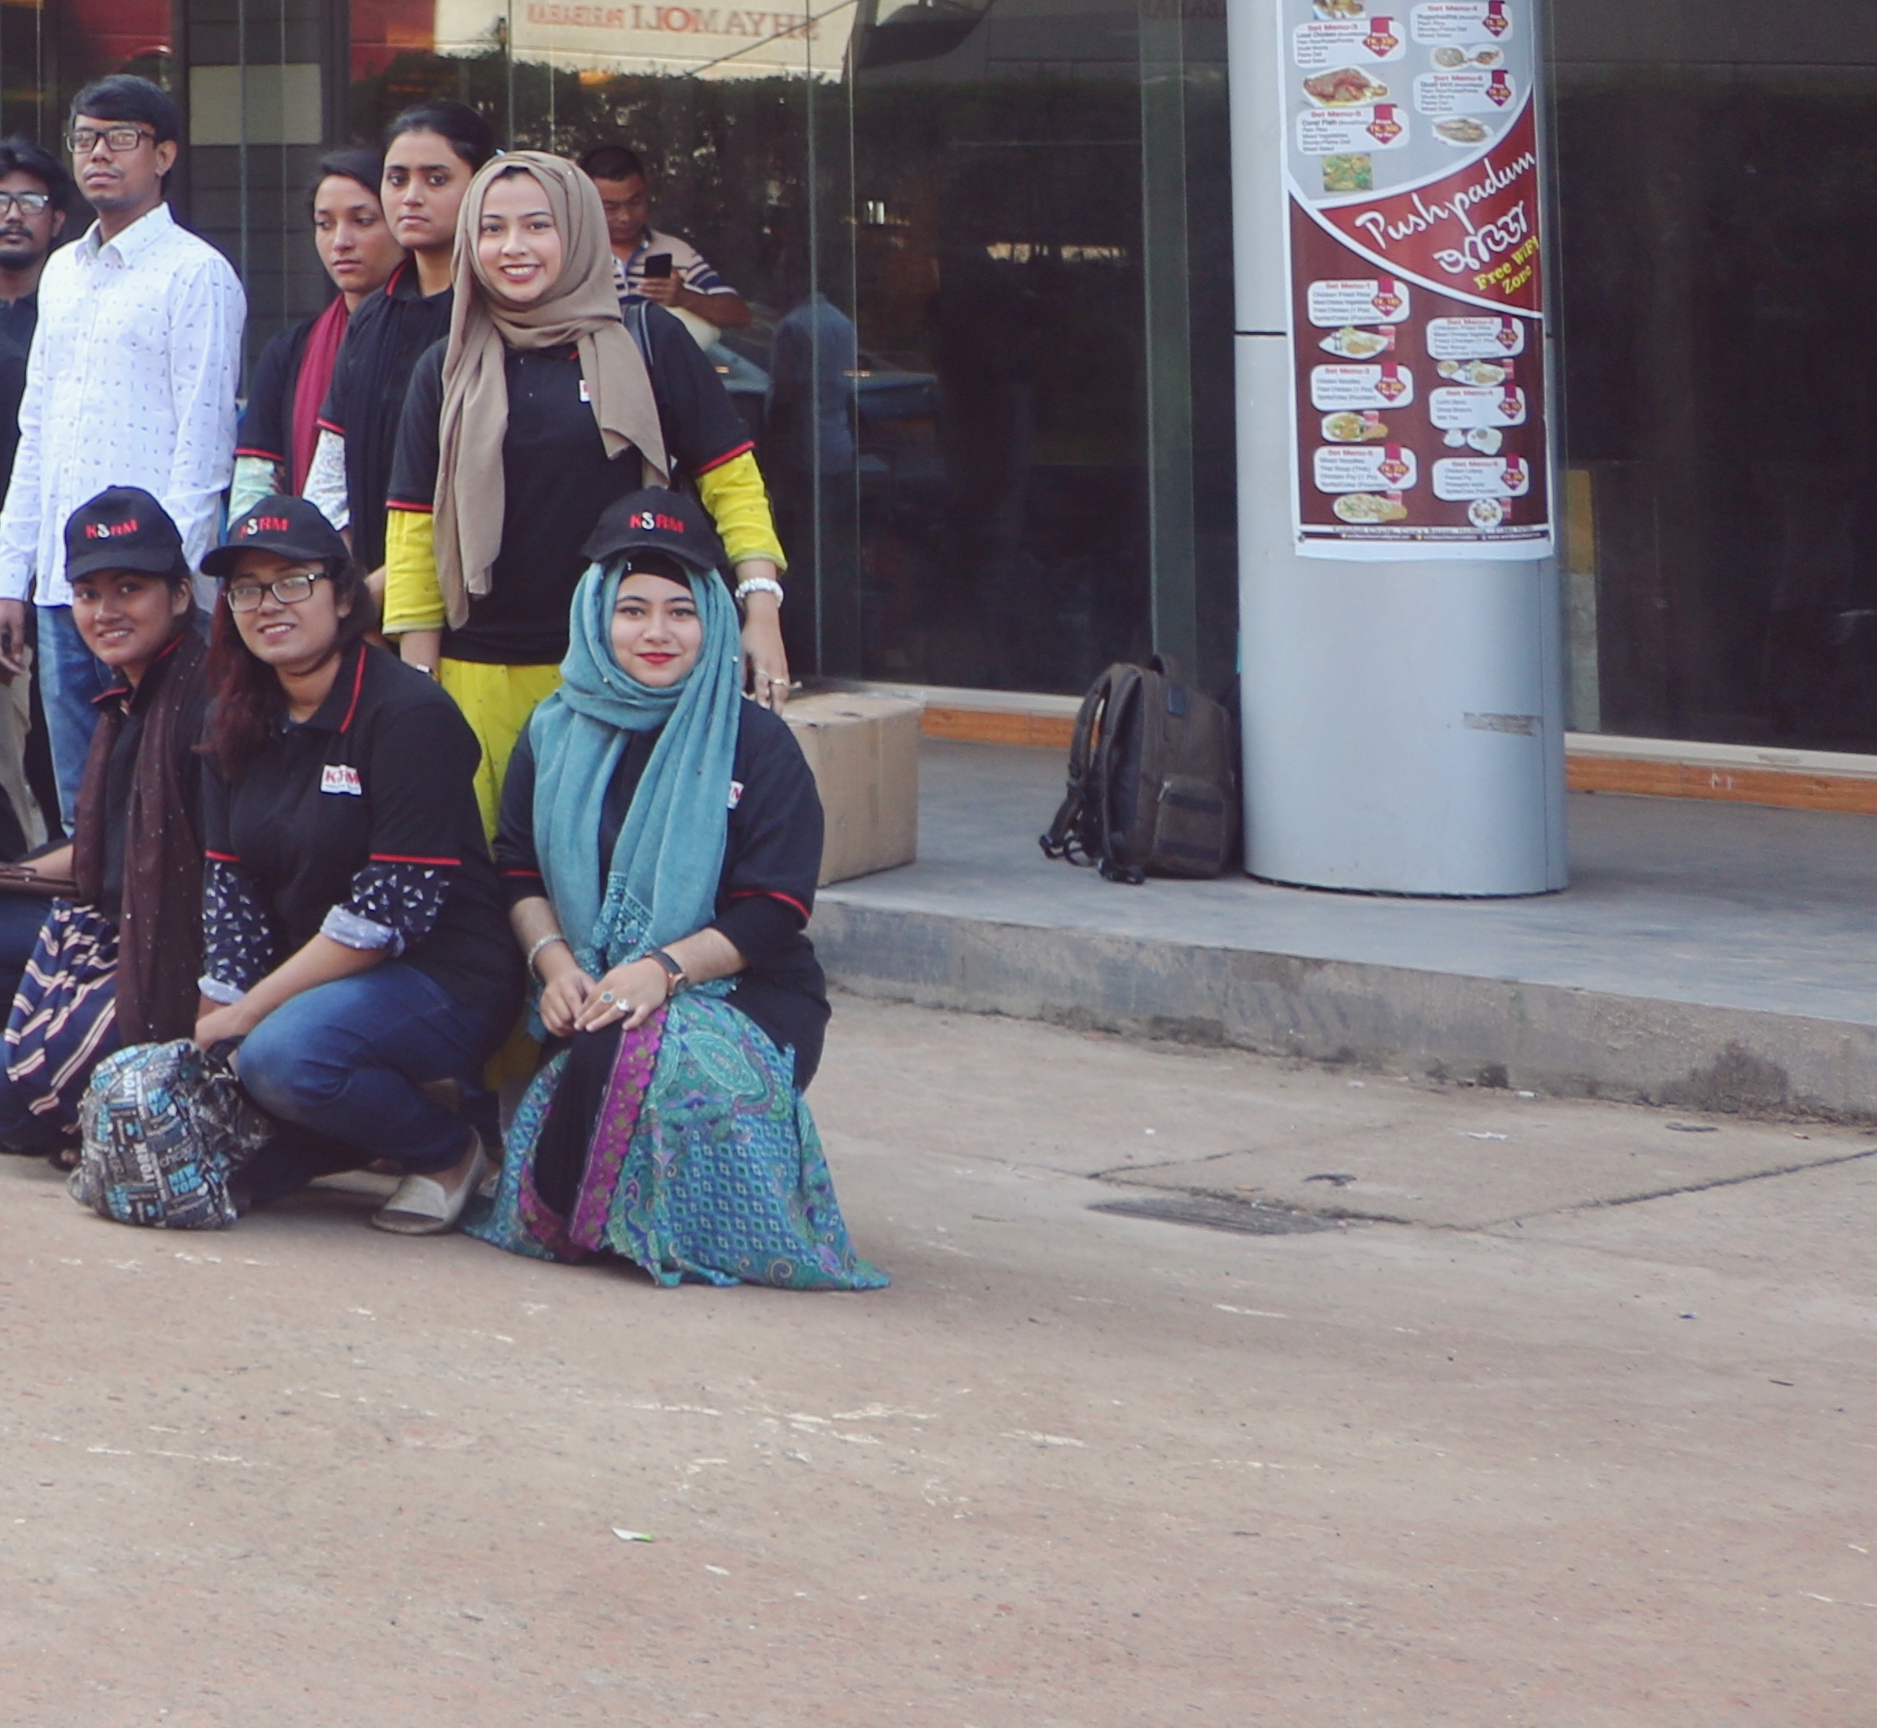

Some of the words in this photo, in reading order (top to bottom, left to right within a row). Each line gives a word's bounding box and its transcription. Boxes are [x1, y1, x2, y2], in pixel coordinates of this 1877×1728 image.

[1355, 152, 1536, 249] Pushpadum
[1473, 262, 1512, 291] Free
[1501, 265, 1532, 295] Zone
[85, 518, 139, 539] KSRM
[629, 511, 686, 534] KSRM
